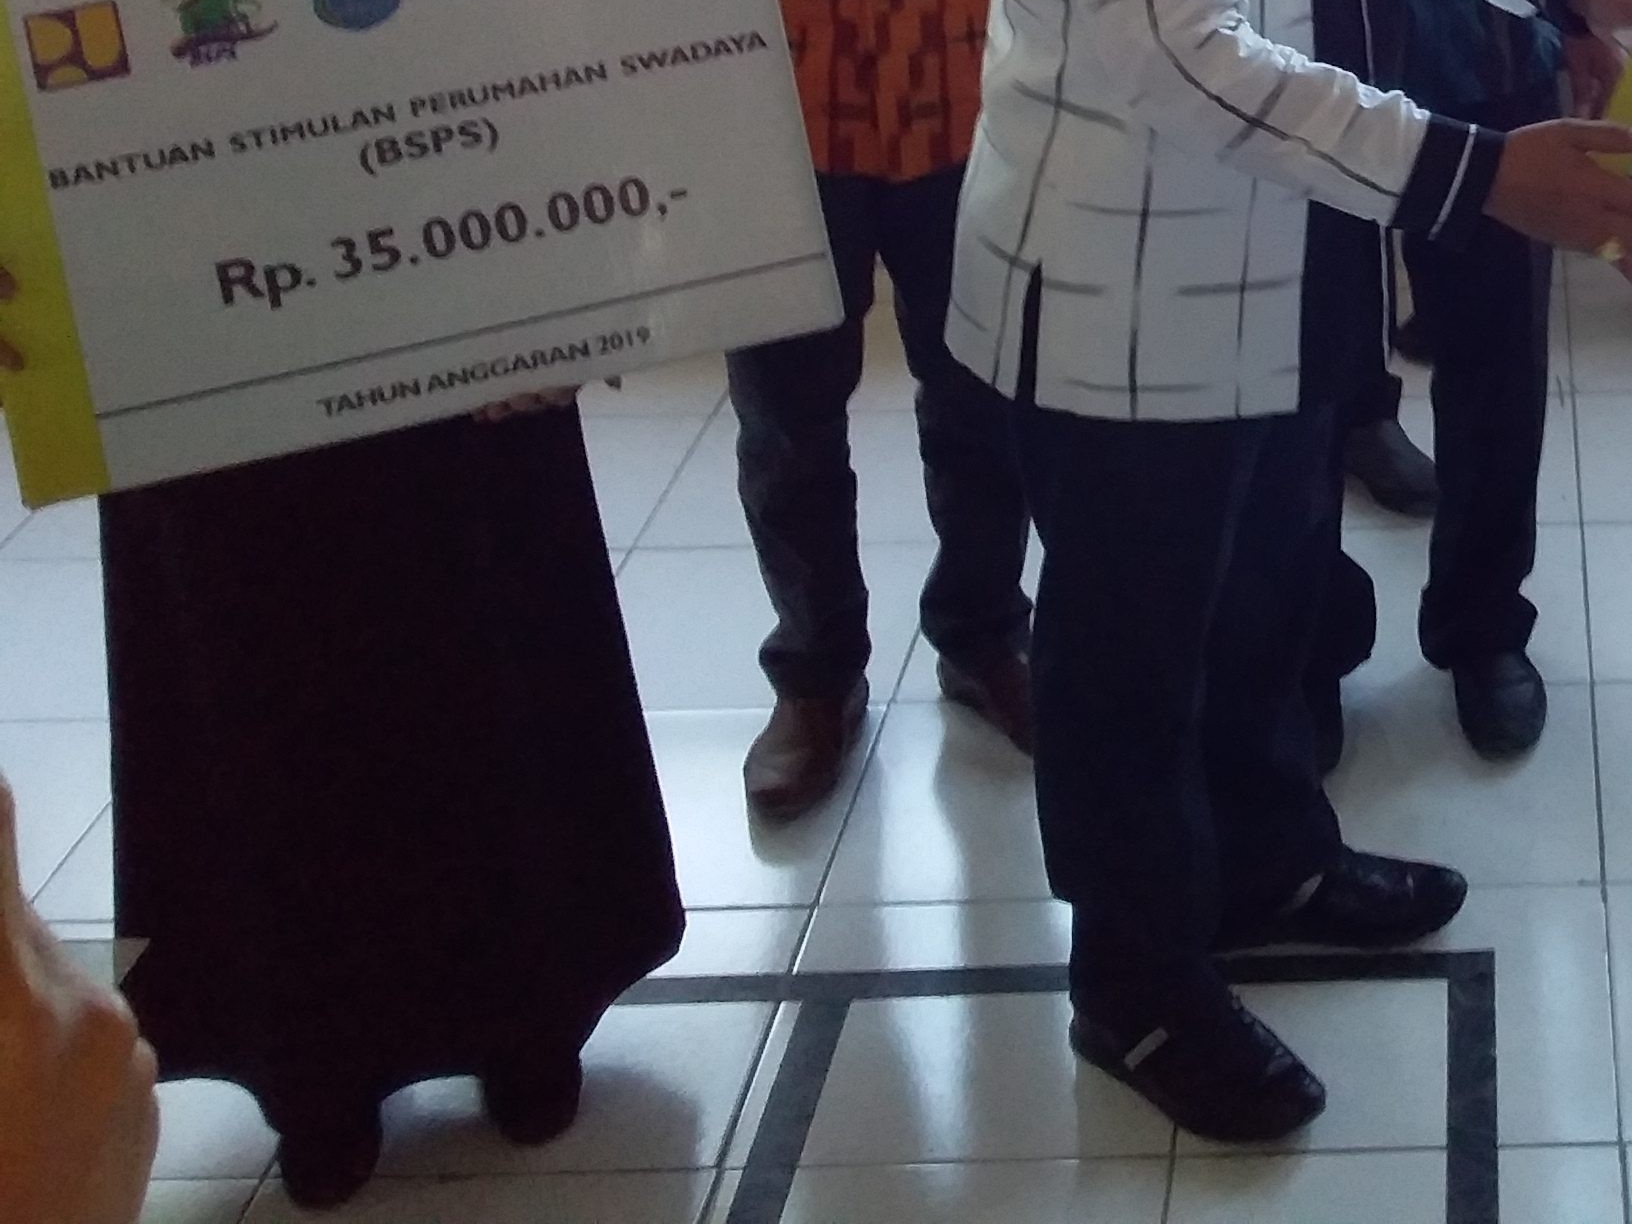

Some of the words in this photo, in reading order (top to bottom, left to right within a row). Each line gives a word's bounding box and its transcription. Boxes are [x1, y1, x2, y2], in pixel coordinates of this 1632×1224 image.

[48, 139, 215, 191] BANTUAN
[228, 102, 397, 154] STIMULAN
[408, 60, 609, 119] PERUMAHAN
[618, 28, 769, 78] SWADAYA
[358, 117, 501, 176] (BSPS)
[214, 255, 317, 312] Rp.
[332, 175, 691, 284] 35.000.000,-
[316, 379, 424, 419] TAHUN
[424, 338, 593, 396] ANGGARAN
[597, 326, 653, 358] 2019
